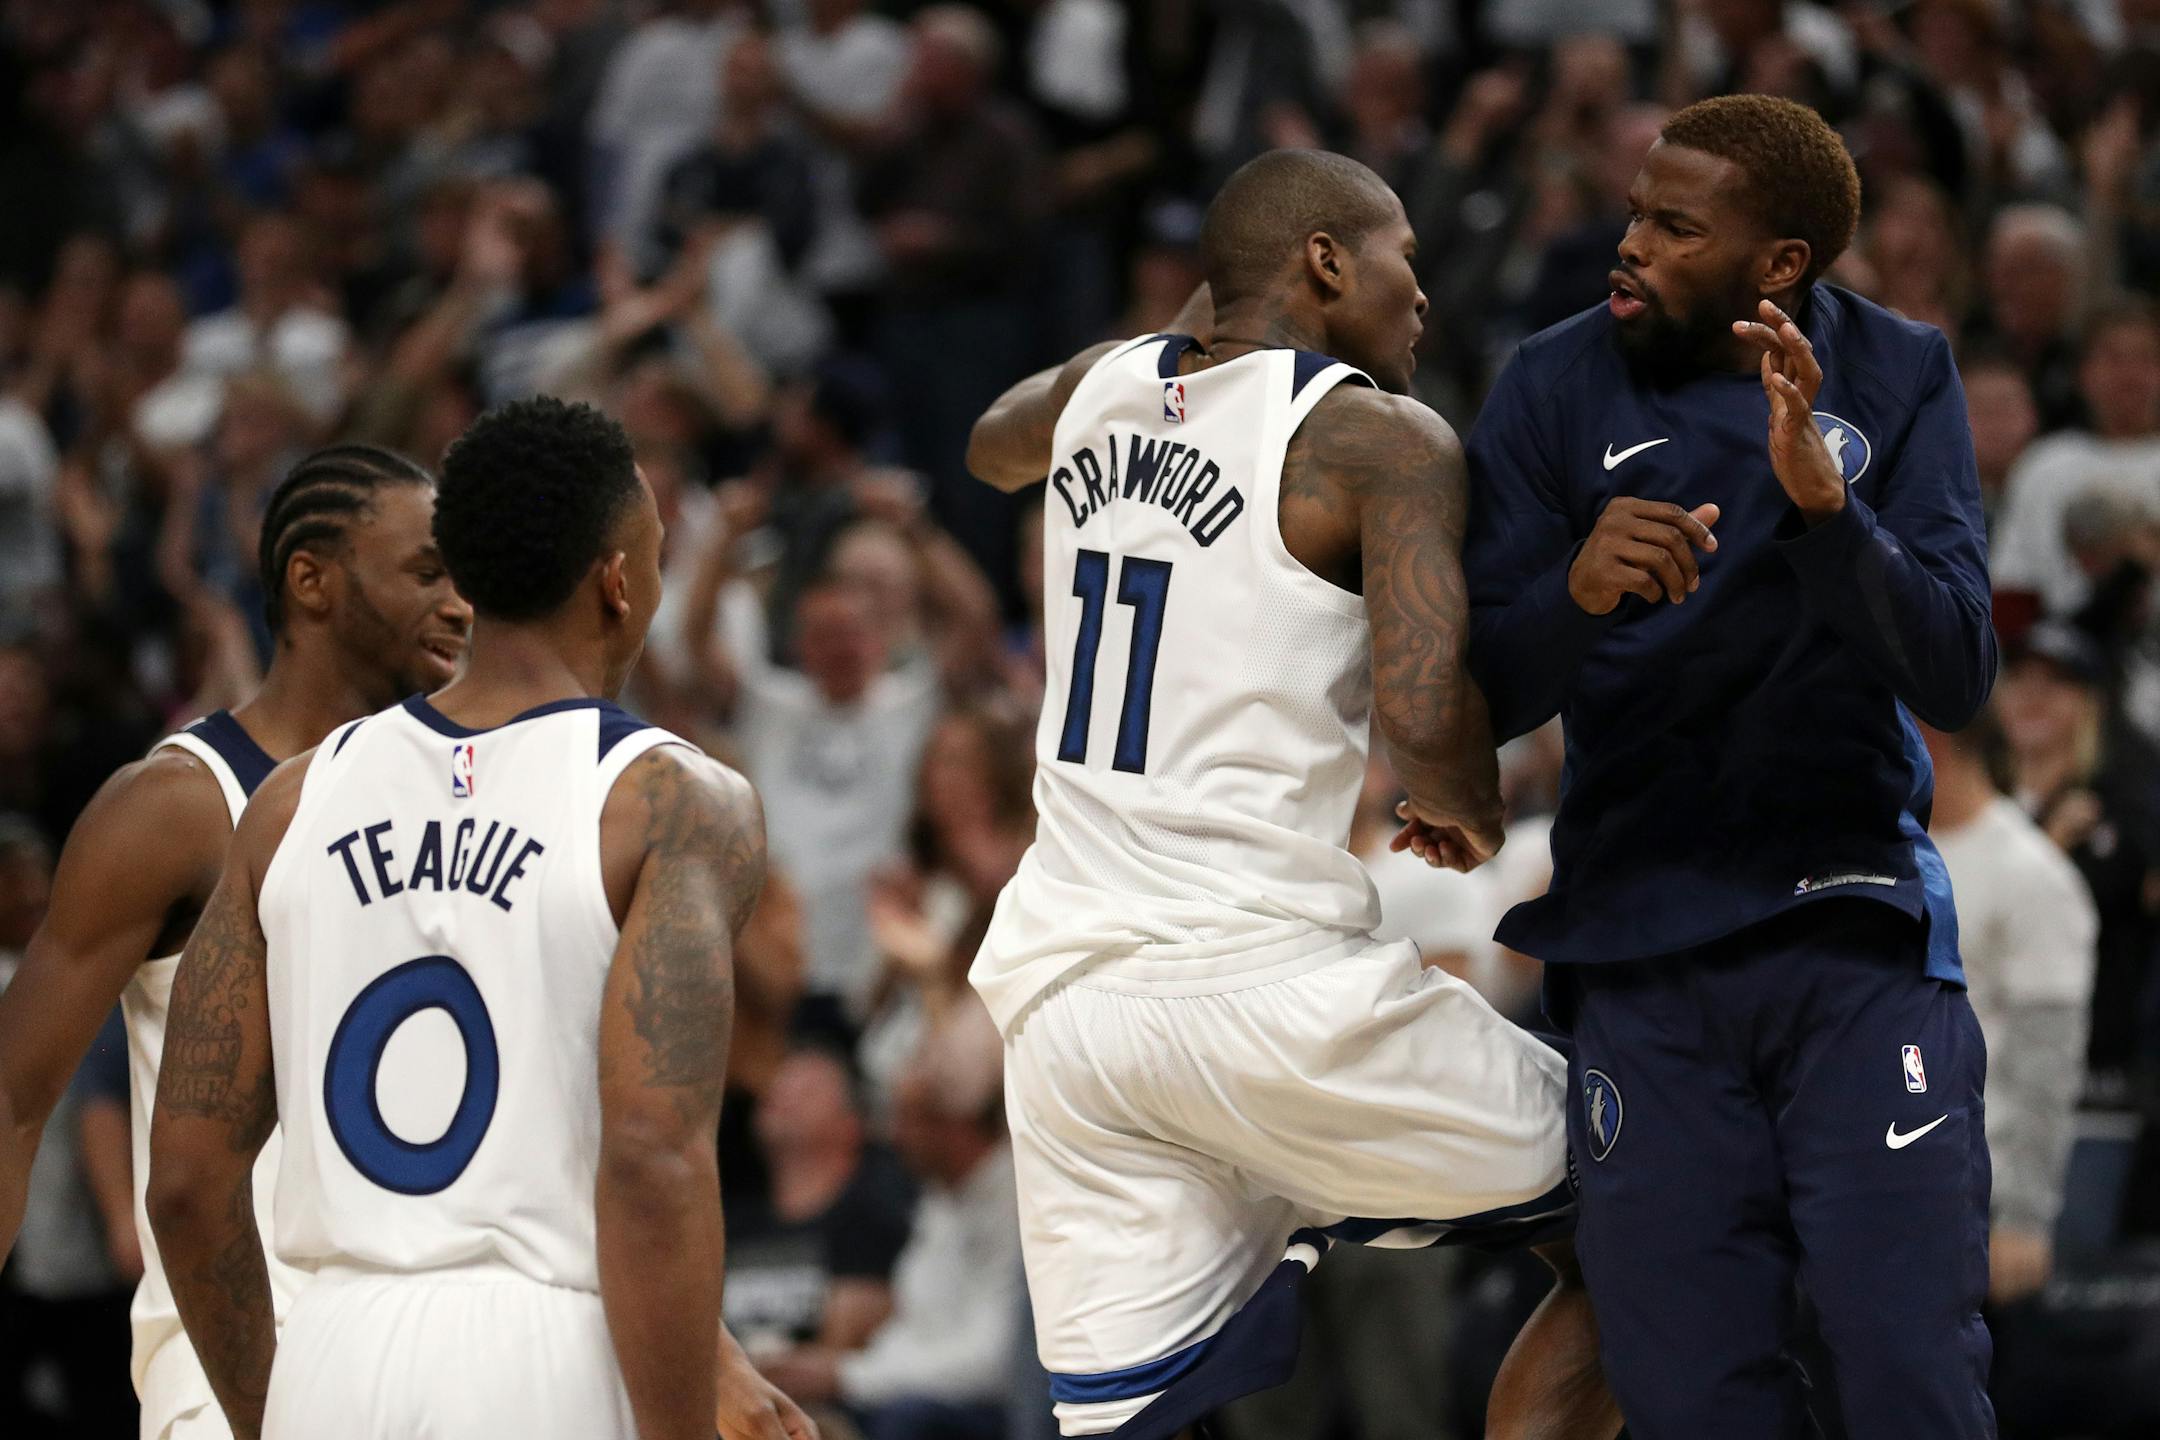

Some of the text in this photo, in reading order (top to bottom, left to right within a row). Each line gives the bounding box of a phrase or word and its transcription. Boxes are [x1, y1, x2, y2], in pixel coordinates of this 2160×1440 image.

[1053, 433, 1245, 548] CRAWFORD
[1056, 548, 1174, 776] 11
[327, 818, 545, 912] TEAGUE
[323, 954, 500, 1196] 0
